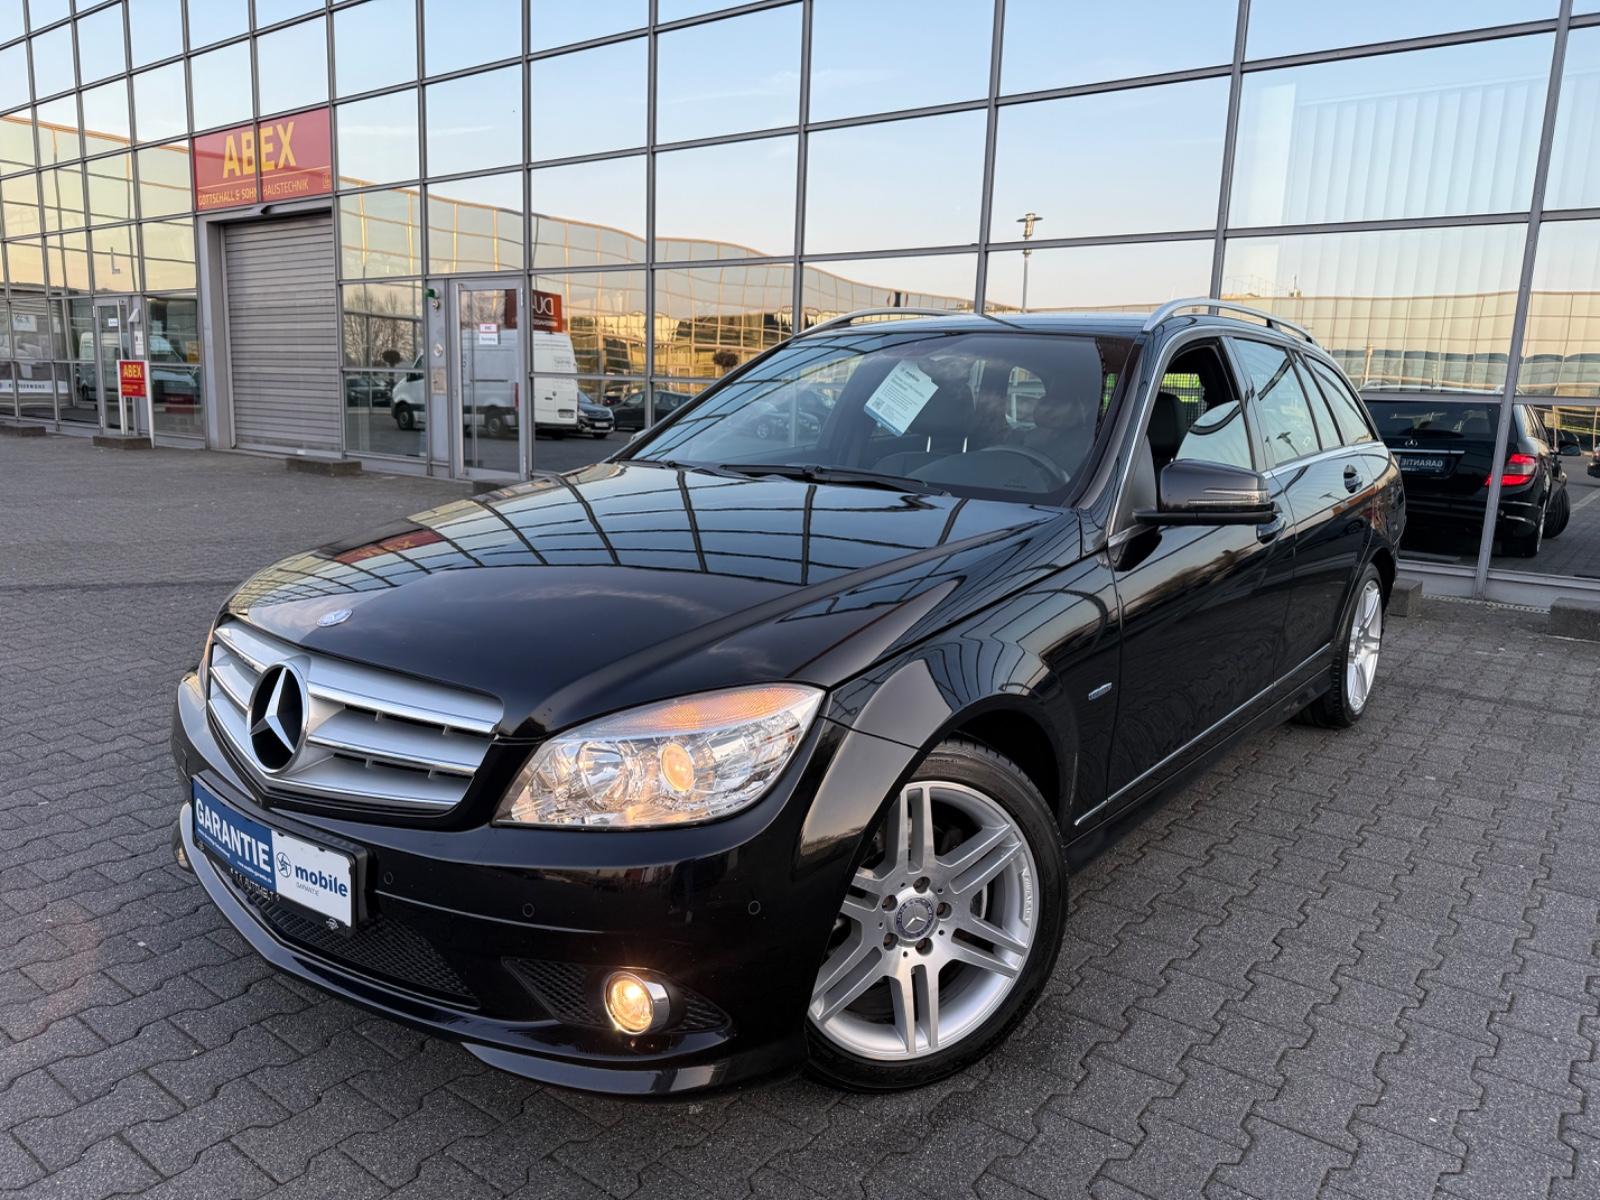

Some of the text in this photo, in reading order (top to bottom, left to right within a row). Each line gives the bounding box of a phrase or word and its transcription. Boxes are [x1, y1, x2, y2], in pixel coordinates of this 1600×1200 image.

[223, 122, 296, 179] ABEX
[123, 364, 142, 378] ABEX
[196, 798, 271, 873] GARANTIE
[295, 865, 348, 897] mobile
